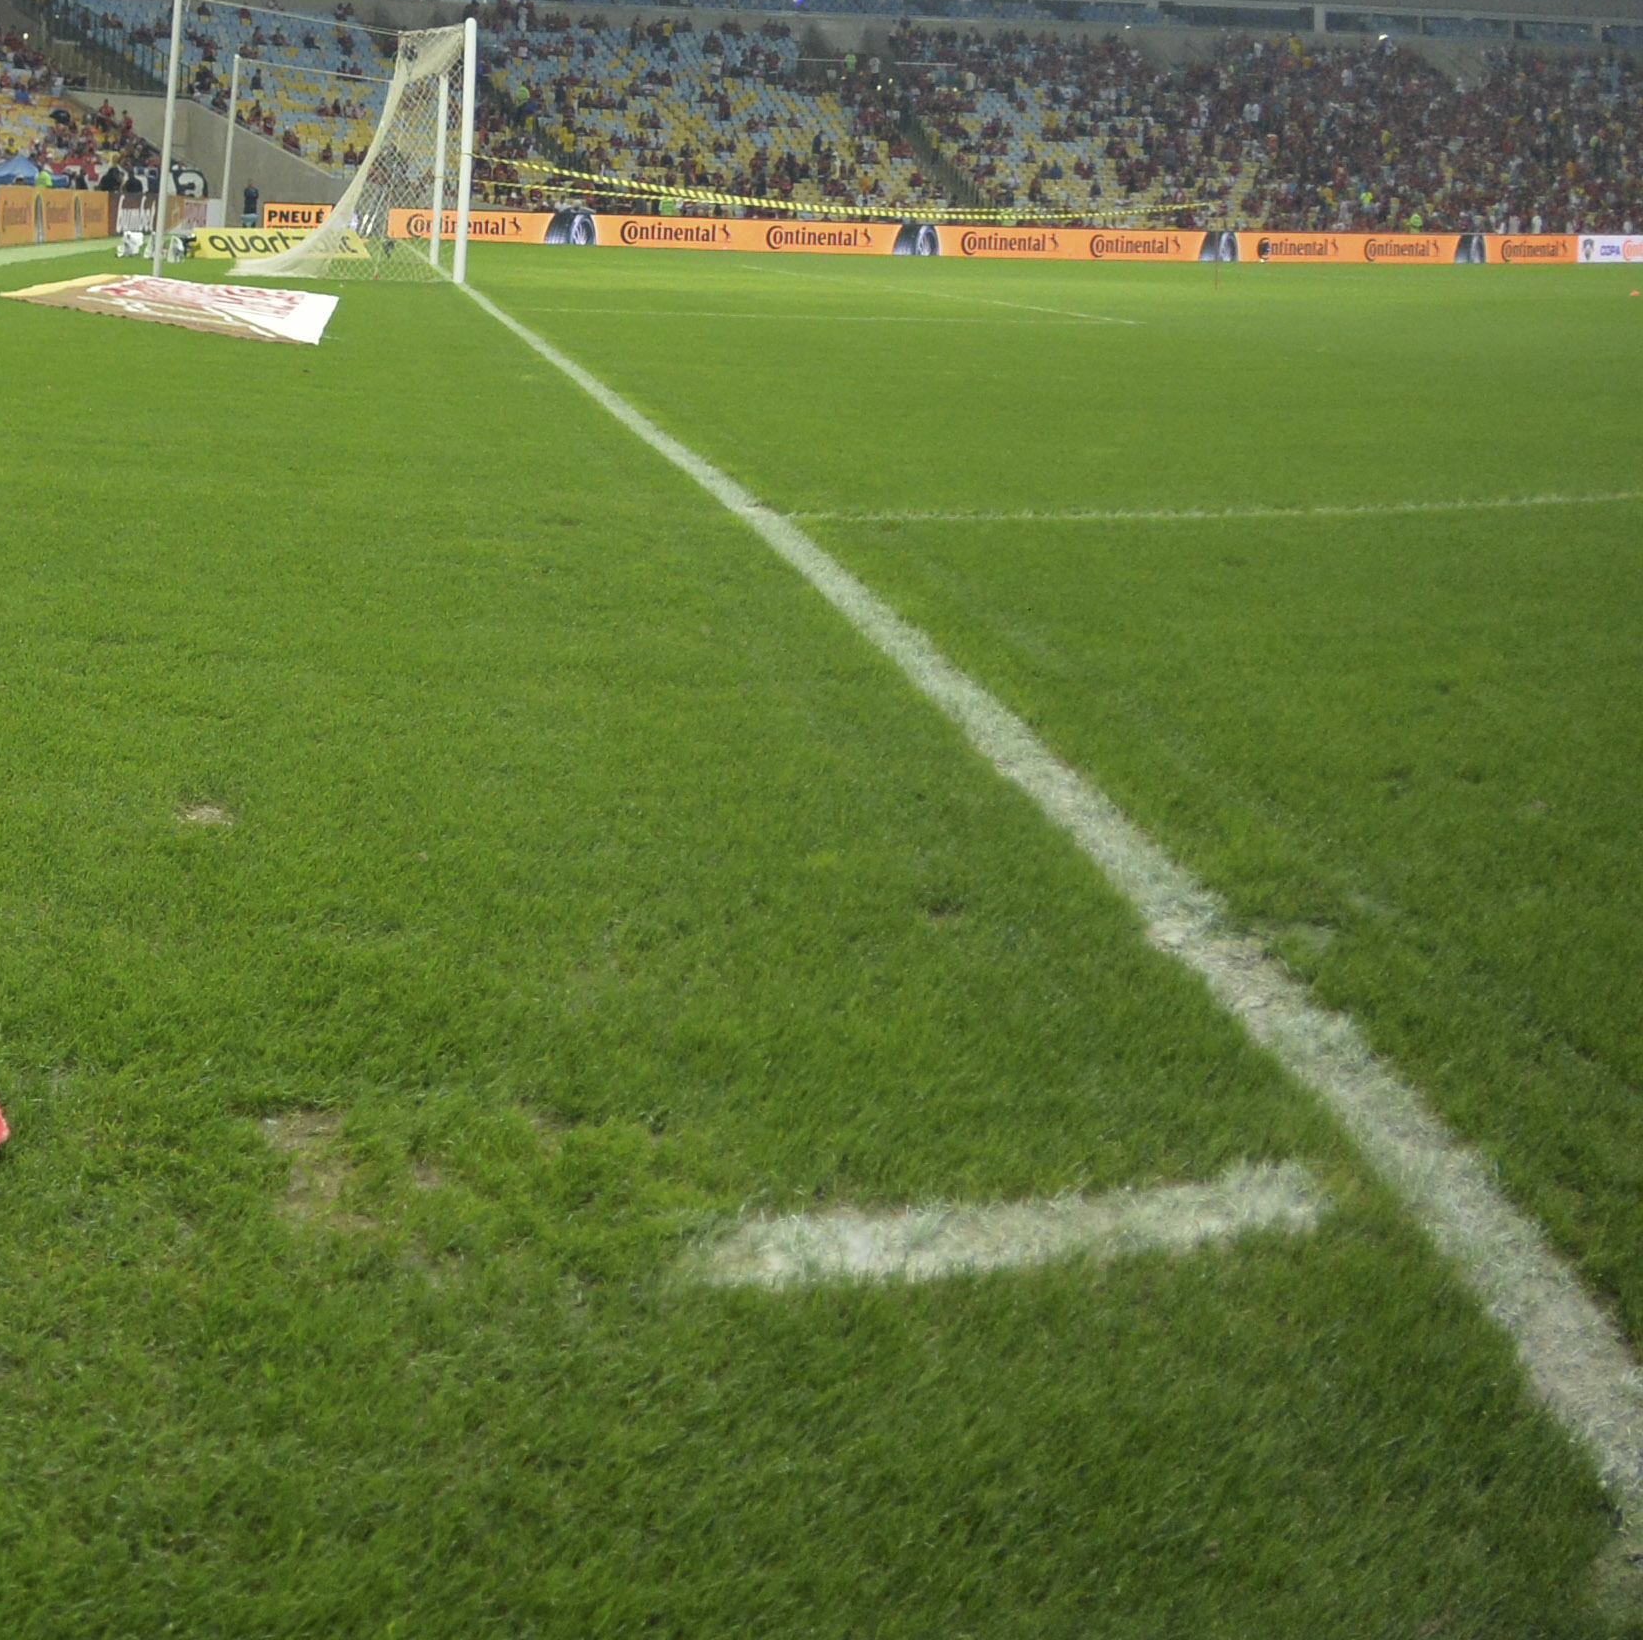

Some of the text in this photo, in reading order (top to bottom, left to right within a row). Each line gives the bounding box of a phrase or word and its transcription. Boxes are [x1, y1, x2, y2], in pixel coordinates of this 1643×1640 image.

[267, 207, 325, 224] PNEU É
[620, 220, 716, 244] Continental
[766, 225, 858, 249] Continental
[961, 231, 1047, 255] Continental
[1090, 234, 1169, 258] Continental
[1256, 237, 1328, 260] Cntinental
[1364, 238, 1431, 261] Continental
[1501, 239, 1559, 263] Continental
